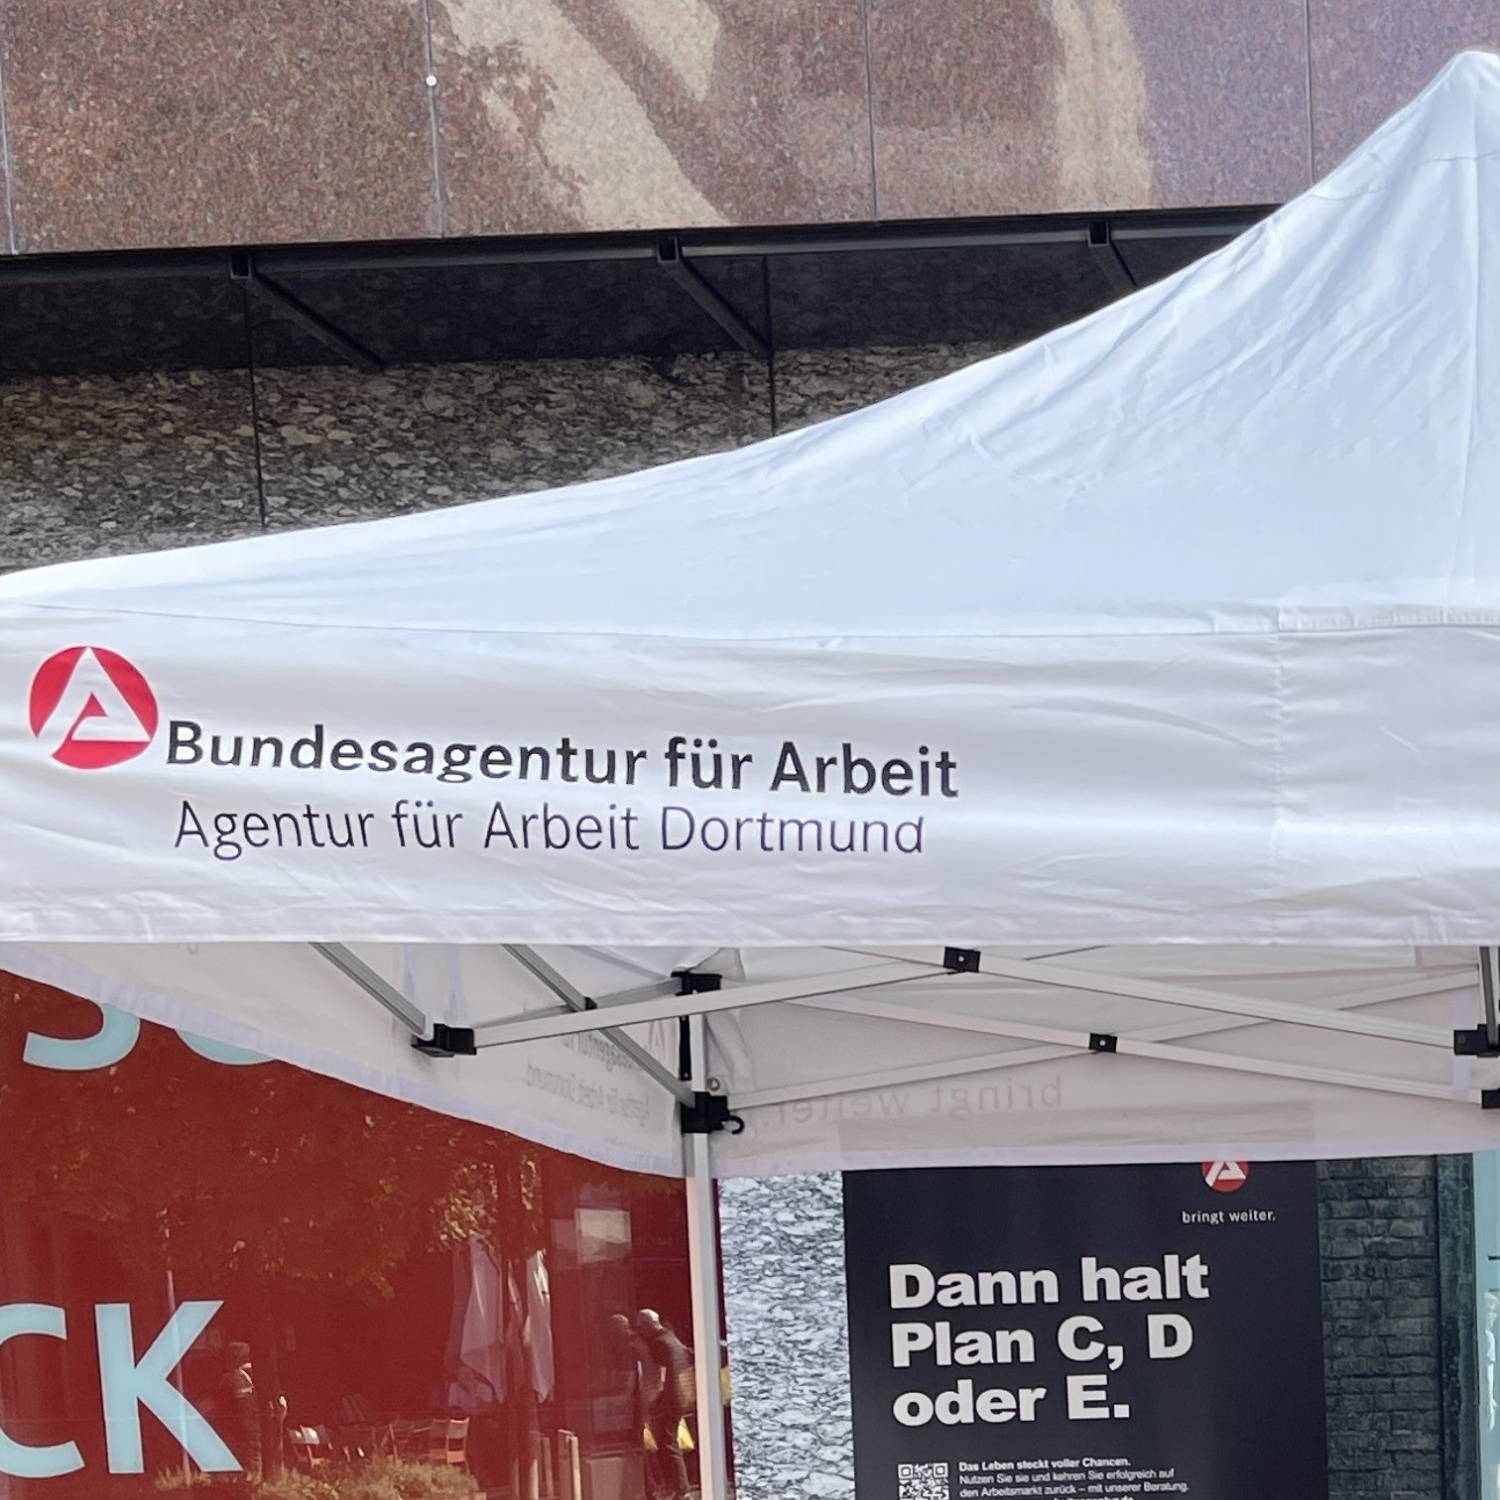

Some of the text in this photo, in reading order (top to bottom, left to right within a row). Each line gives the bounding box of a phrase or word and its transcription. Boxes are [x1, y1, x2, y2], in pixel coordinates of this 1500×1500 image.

[166, 719, 960, 798] Bundesagentur für Arbeit
[173, 799, 925, 861] Agentur für Arbeit Dortmund
[1182, 1208, 1276, 1225] bringt weiter.
[889, 1254, 1210, 1309] Dann halt
[891, 1314, 1193, 1371] Plan C, D
[893, 1374, 1131, 1426] oder E.
[959, 1457, 1131, 1472] Das Leben steckt voller Chancen.
[959, 1474, 994, 1484] Nutzen
[996, 1473, 1013, 1483] Sie
[1031, 1472, 1050, 1482] und
[1088, 1470, 1104, 1480] Sie
[1106, 1468, 1157, 1481] erfolgreich
[1158, 1468, 1175, 1478] auf
[960, 1488, 979, 1498] den
[981, 1485, 1043, 1497] Arbeitsmarkt
[1044, 1484, 1077, 1495] zurück
[1088, 1484, 1103, 1493] mit
[1104, 1484, 1141, 1493] unserer
[1143, 1481, 1190, 1493] Beratung.
